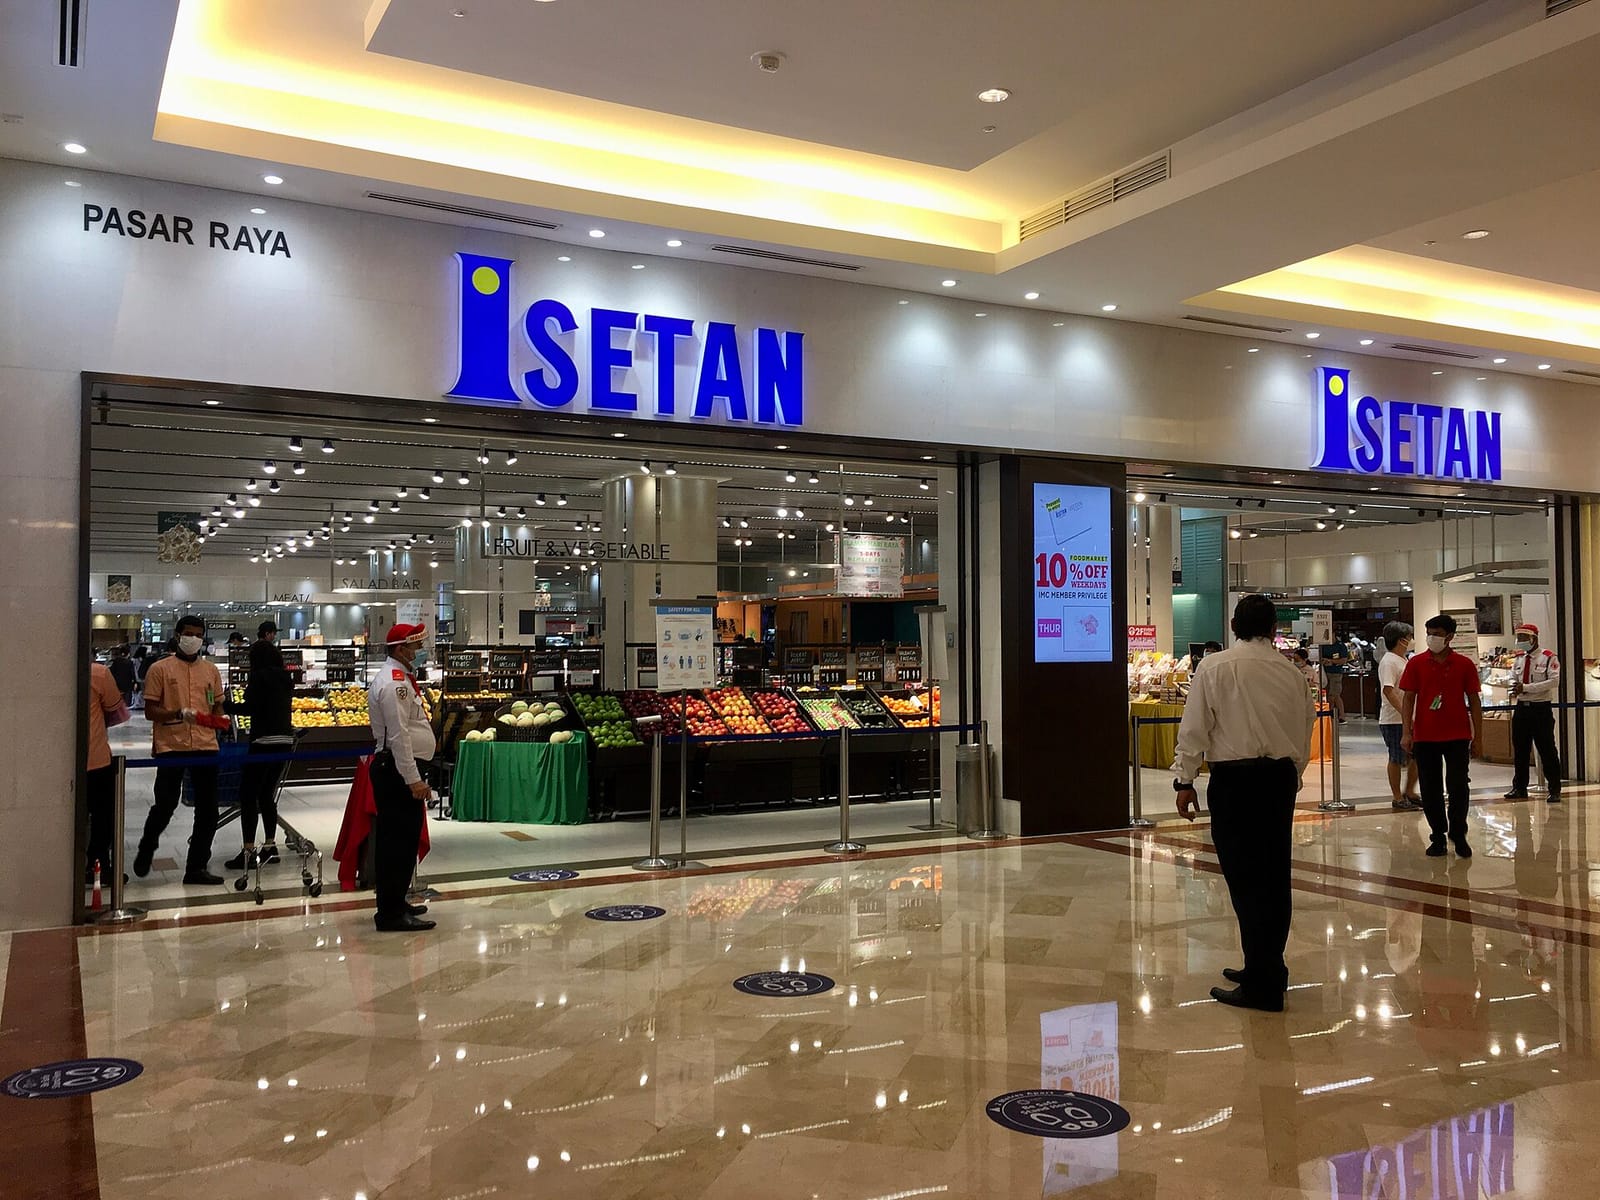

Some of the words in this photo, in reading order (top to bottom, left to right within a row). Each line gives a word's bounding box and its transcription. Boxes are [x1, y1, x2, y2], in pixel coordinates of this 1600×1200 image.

[83, 203, 194, 245] PASAR
[209, 221, 291, 258] RAYA
[494, 538, 540, 556] FRUIT
[544, 541, 559, 557] &
[563, 541, 671, 560] VEGETABLE
[1035, 552, 1067, 589] 10
[342, 577, 389, 590] SALAD
[392, 577, 421, 590] BAR
[1071, 580, 1107, 589] WEEKDAYS
[1038, 591, 1050, 599] IMC
[1051, 591, 1077, 599] MEMBER
[1078, 591, 1108, 600] PRIVILEGE
[1038, 623, 1062, 633] THUR
